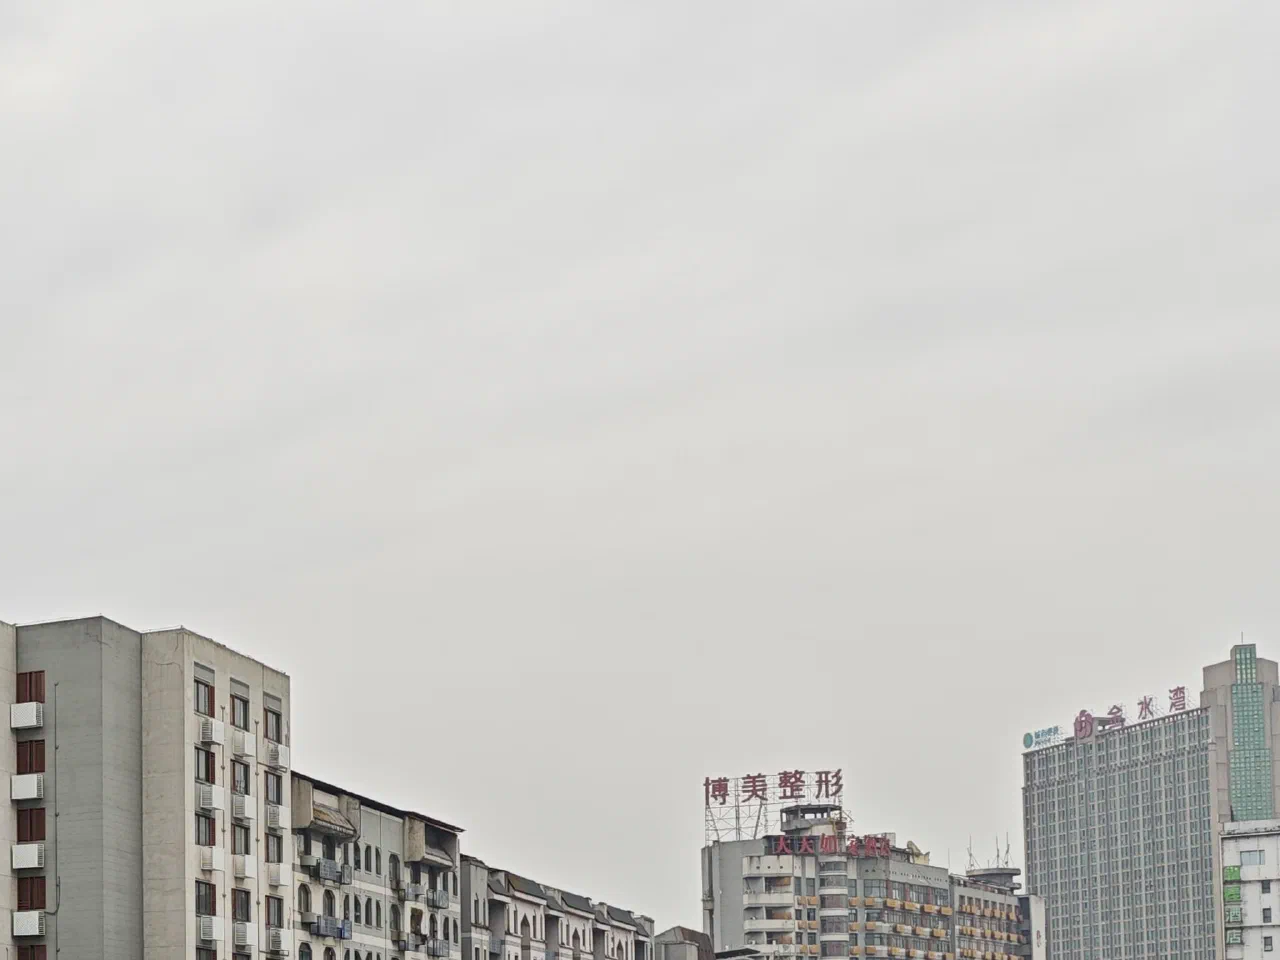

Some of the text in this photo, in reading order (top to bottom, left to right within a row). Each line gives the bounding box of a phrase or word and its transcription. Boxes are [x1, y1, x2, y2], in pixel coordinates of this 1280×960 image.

[1107, 686, 1186, 729] 金水湾
[703, 768, 844, 805] 博美整形
